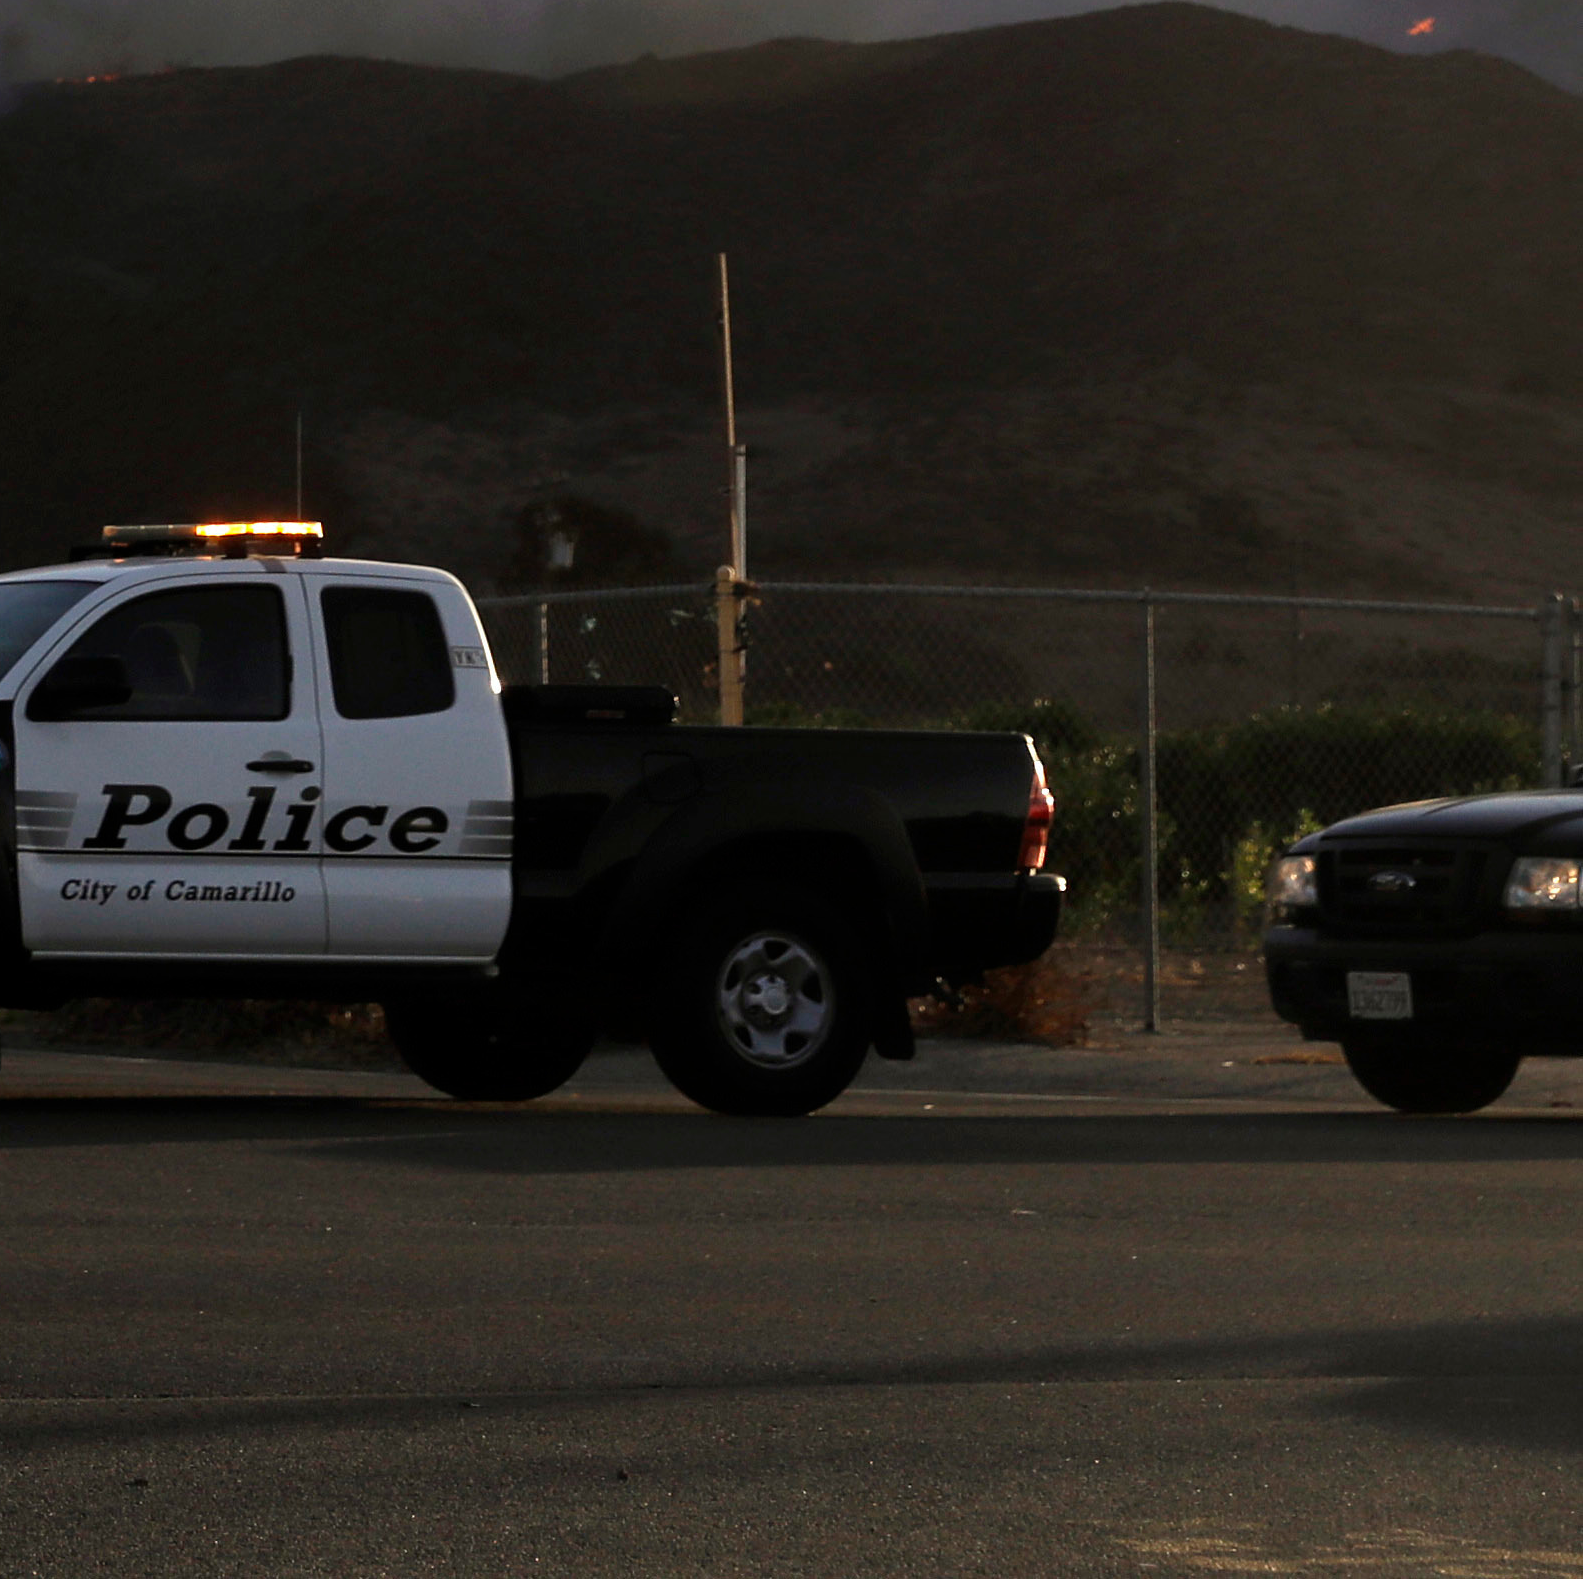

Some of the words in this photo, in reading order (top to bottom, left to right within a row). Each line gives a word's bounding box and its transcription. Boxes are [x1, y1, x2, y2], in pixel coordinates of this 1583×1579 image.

[83, 784, 448, 852] Police
[60, 879, 117, 906] City
[127, 880, 156, 902] of
[165, 880, 296, 903] Camarillo
